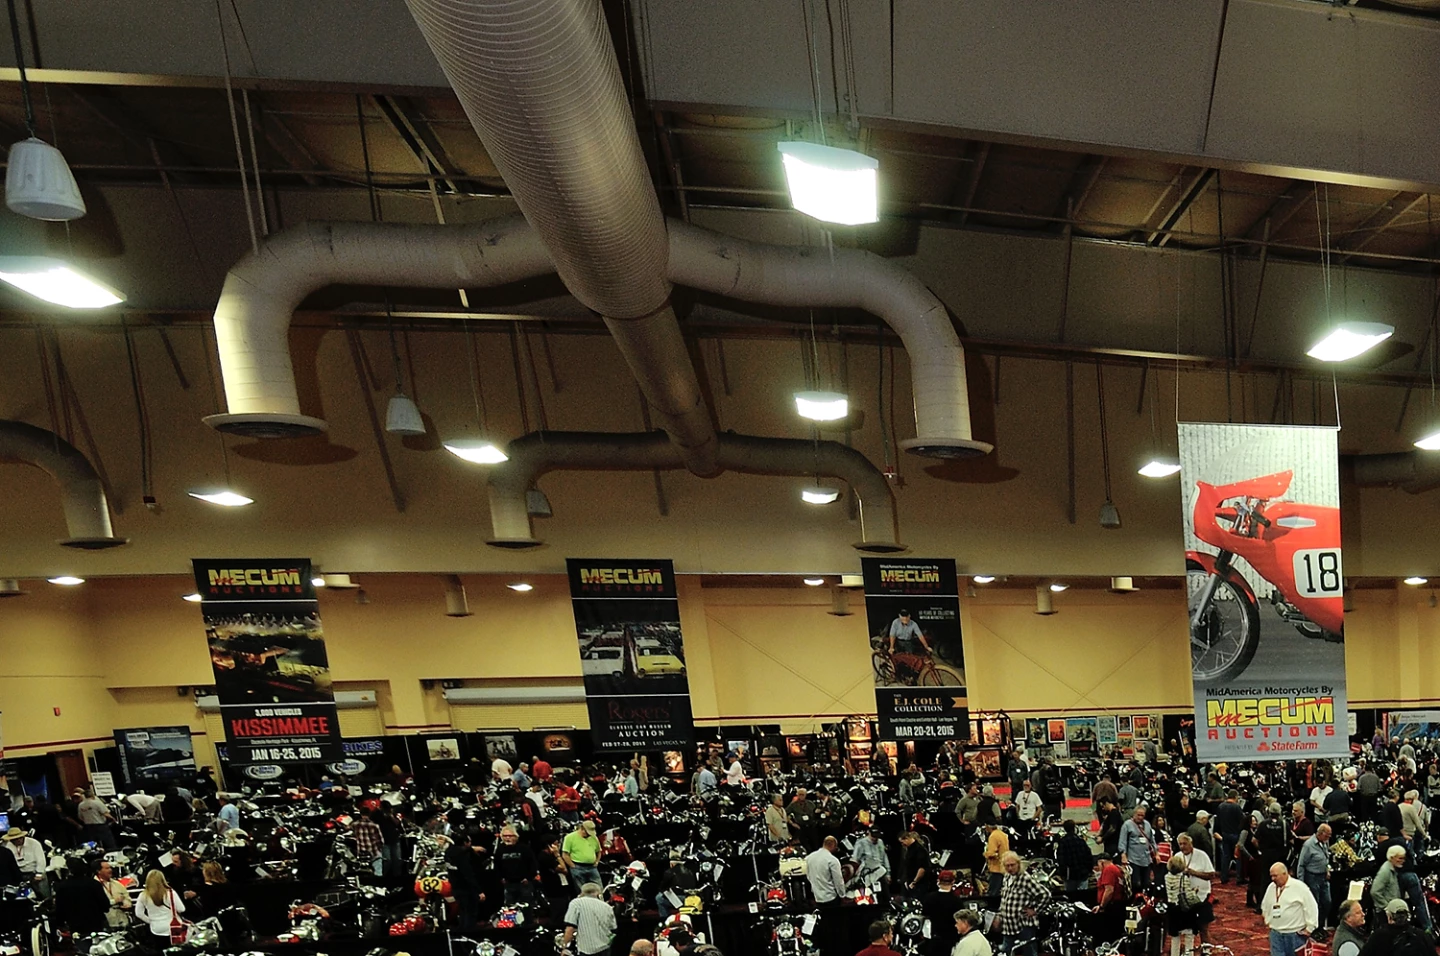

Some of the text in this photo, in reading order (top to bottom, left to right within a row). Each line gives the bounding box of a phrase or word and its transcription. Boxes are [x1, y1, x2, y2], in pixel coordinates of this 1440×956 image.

[208, 569, 301, 585] MECUM
[580, 568, 662, 584] MECUM
[880, 569, 940, 583] MECUM
[1303, 552, 1339, 592] 18
[209, 586, 303, 594] AUCTIONS
[1206, 686, 1333, 696] MidAmerica Motorcycles By
[274, 708, 302, 716] VEHICLES
[1206, 697, 1335, 727] MECUM
[231, 717, 329, 737] KISSIMMEE
[895, 725, 954, 737] MAR 20-21, 2015
[1208, 725, 1335, 740] AUCTIONS
[619, 730, 664, 738] AUCTION
[342, 740, 383, 752] BIKES
[251, 747, 322, 760] JAN 16-25, 2015
[423, 879, 439, 892] 82
